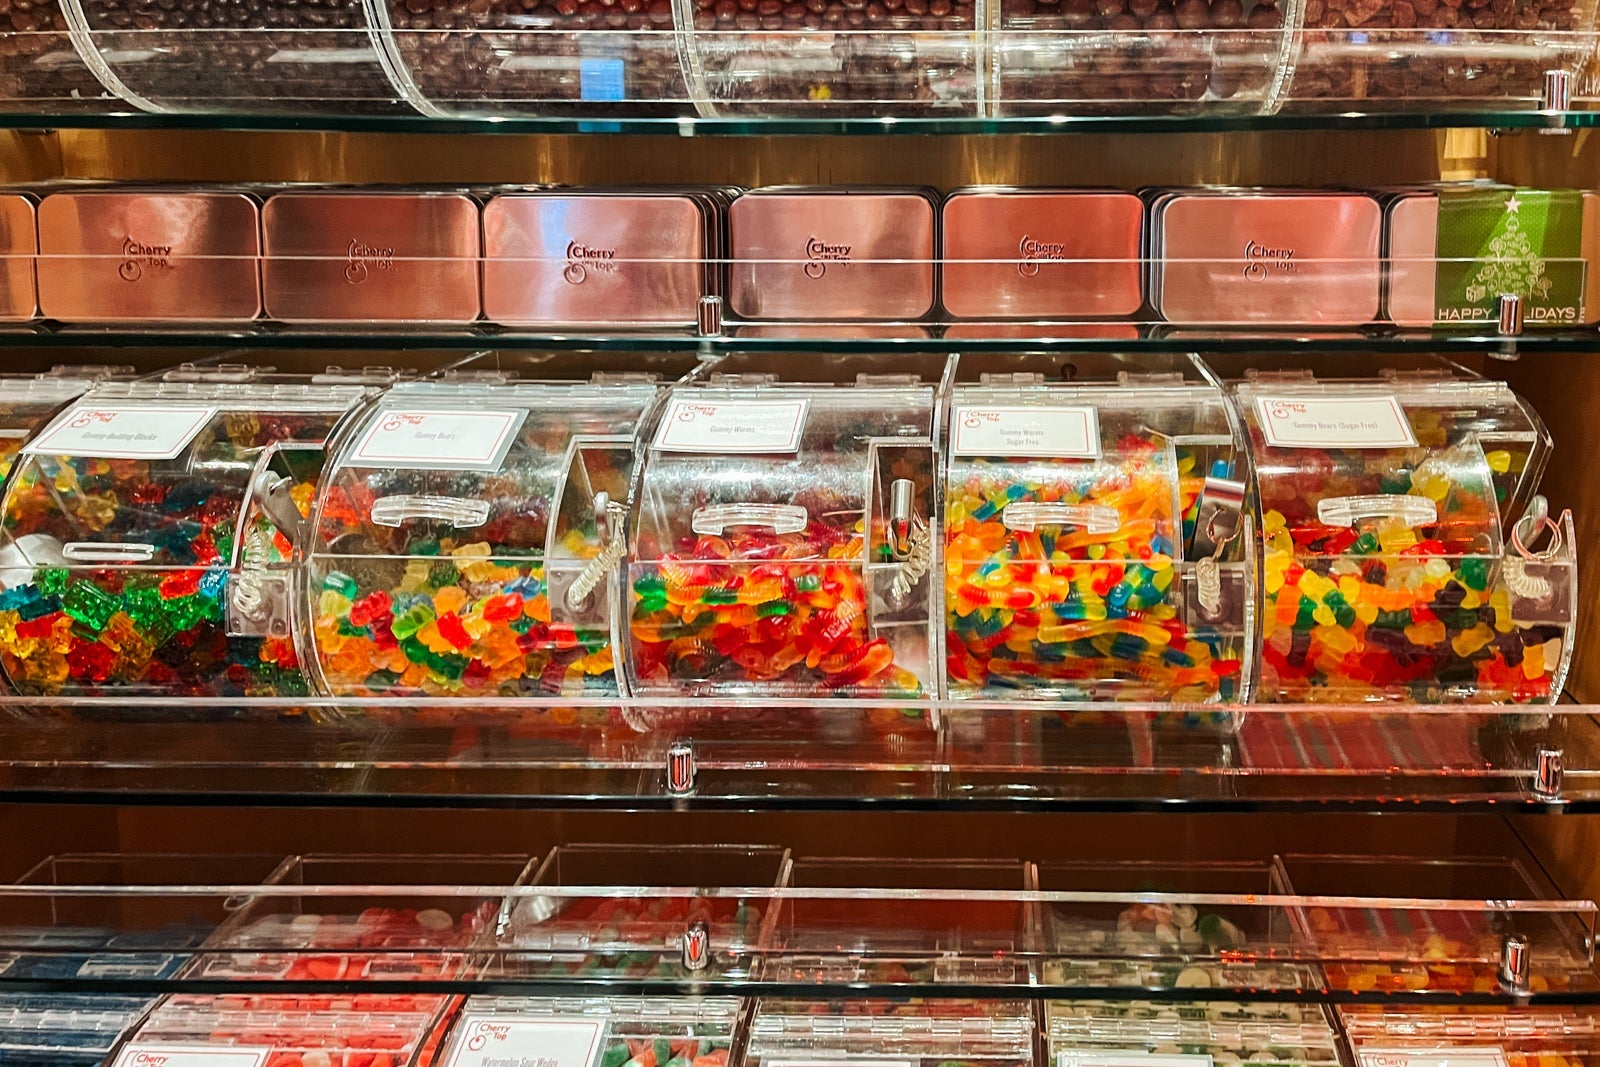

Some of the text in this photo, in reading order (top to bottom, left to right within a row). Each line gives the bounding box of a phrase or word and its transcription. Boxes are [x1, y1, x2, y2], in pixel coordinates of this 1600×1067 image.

[128, 243, 171, 256] Cherry
[353, 245, 395, 257] Cherry
[812, 243, 851, 255] Cherry
[1025, 240, 1065, 254] Cherry
[1251, 245, 1294, 259] Cherry
[572, 246, 615, 259] Cherry
[1438, 307, 1493, 320] HAPPY
[687, 404, 718, 412] Cherry
[1274, 401, 1306, 409] Cherry
[395, 412, 426, 421] Cherry
[969, 410, 1001, 419] Cherry
[710, 425, 755, 434] Gummy Worms
[1293, 422, 1317, 431] Gummy
[1338, 422, 1359, 430] (Sugar
[1360, 422, 1378, 430] Free)
[414, 432, 456, 441] Gummy Bears
[1000, 429, 1022, 437] Gummy
[1006, 438, 1024, 446] Sugar
[480, 1023, 511, 1033] Cherry
[493, 1032, 508, 1041] Top
[136, 1054, 169, 1064] Cherry
[481, 1056, 520, 1067] Watermelon
[519, 1056, 538, 1067] Sour
[1376, 1057, 1409, 1067] Cherry
